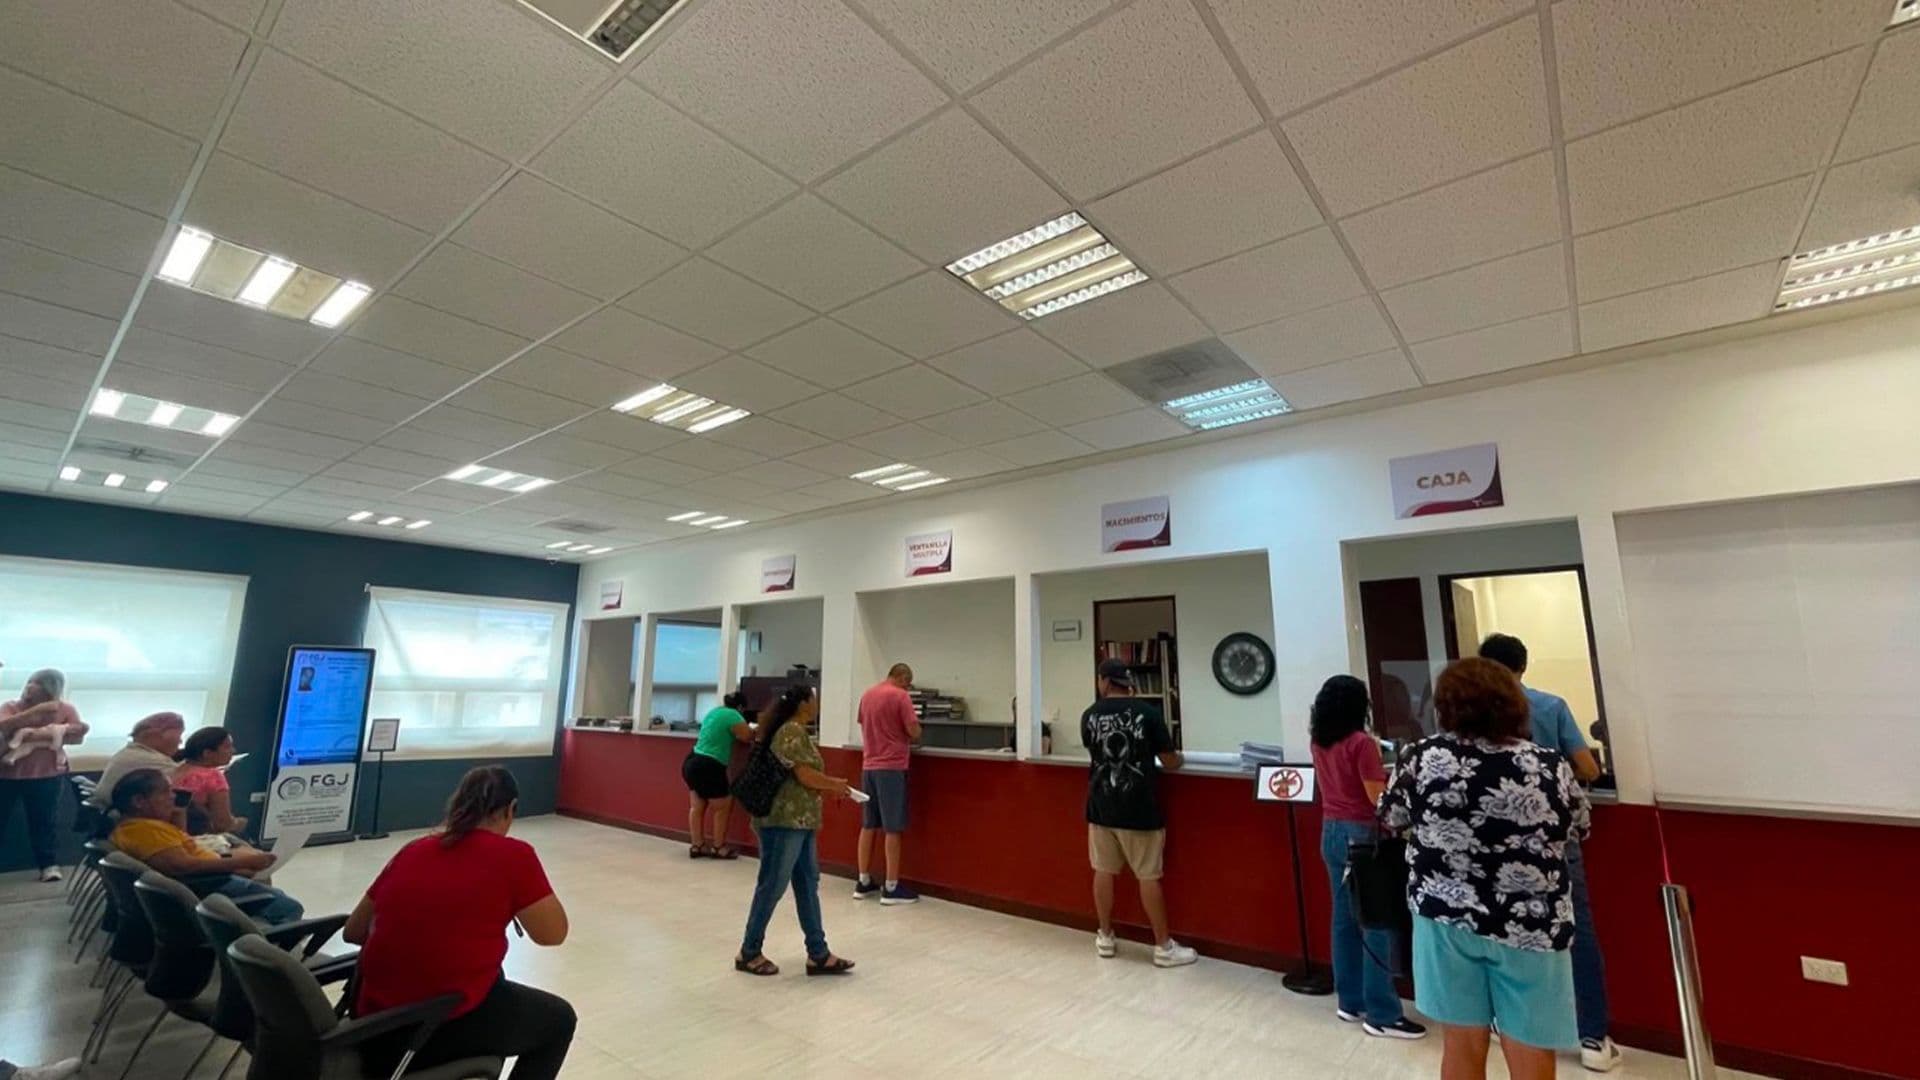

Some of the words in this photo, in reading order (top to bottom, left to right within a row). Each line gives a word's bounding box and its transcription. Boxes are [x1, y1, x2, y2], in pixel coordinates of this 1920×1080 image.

[1416, 470, 1472, 489] CAJA
[1105, 512, 1165, 528] NACIMIENTOS
[909, 541, 948, 551] VENTANILLA
[310, 772, 349, 787] FGJ
